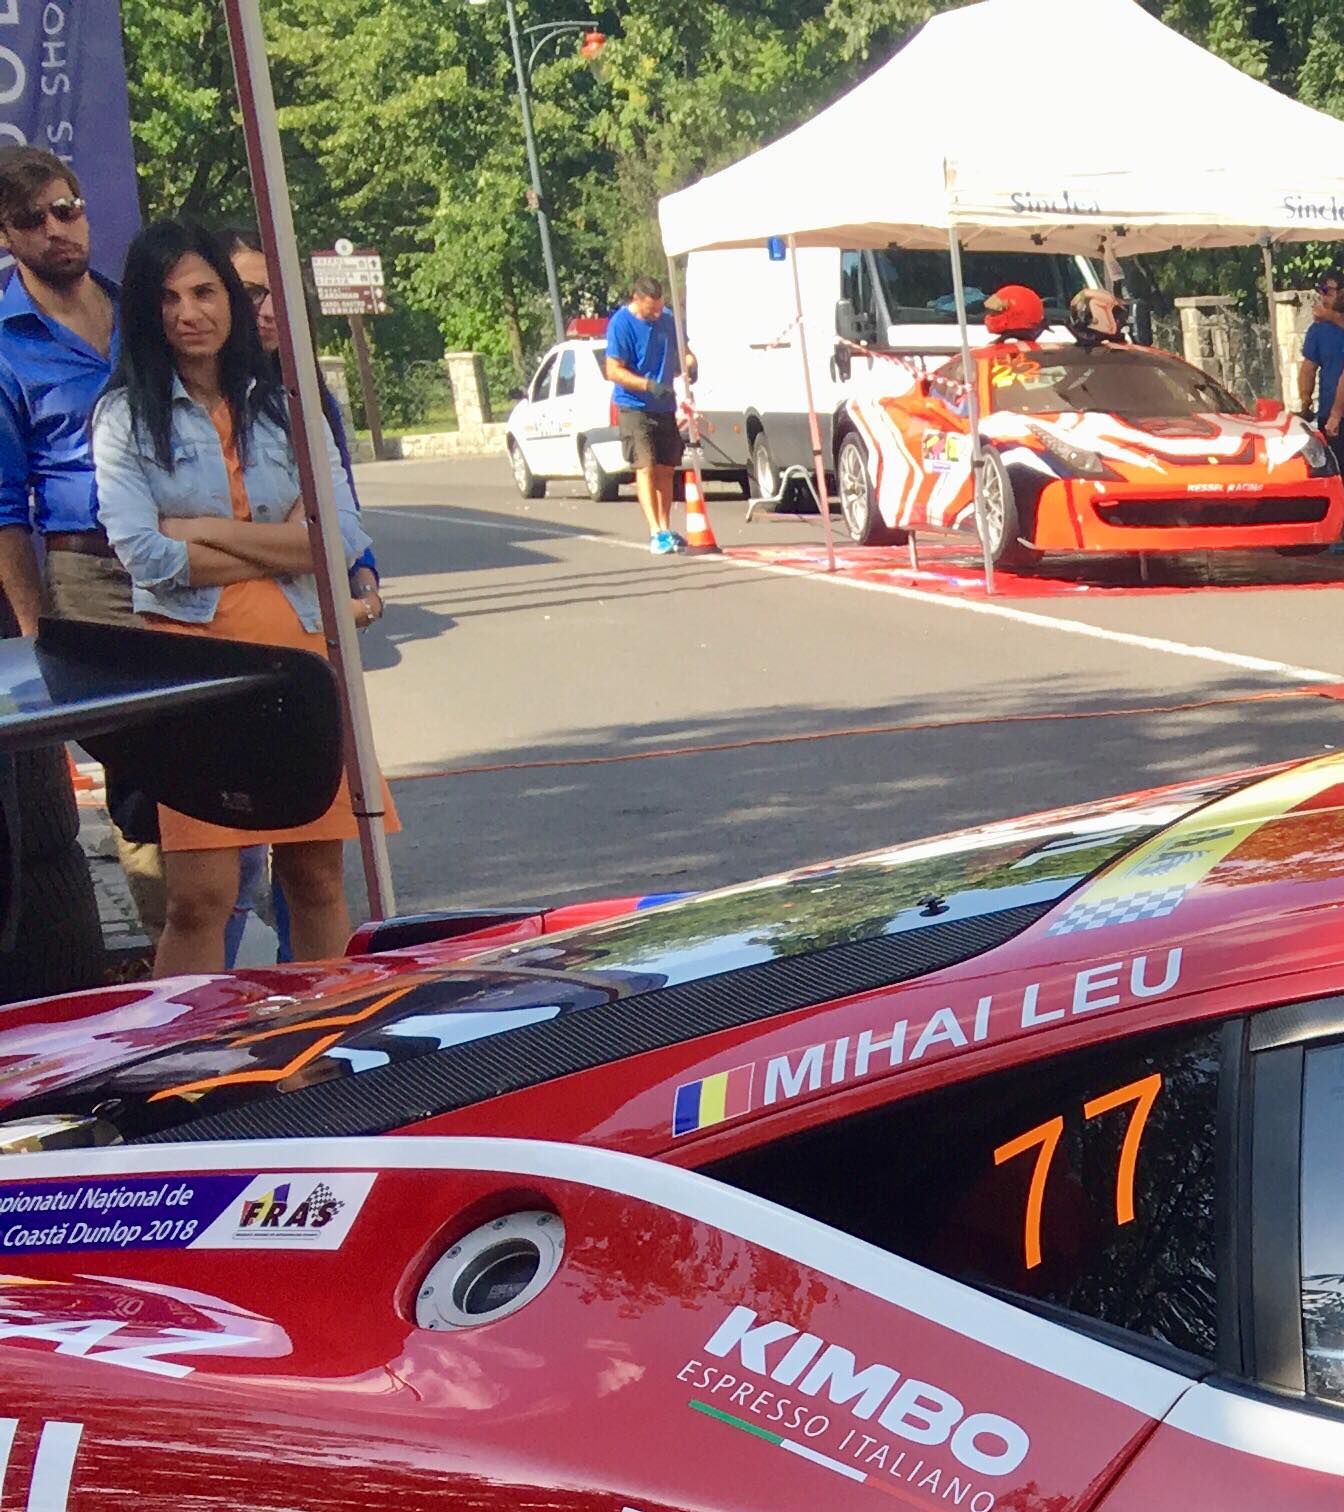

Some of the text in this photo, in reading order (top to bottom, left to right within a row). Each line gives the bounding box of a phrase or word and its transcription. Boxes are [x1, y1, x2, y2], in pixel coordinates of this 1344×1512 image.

[764, 948, 1182, 1106] MIHAI LEU
[165, 1184, 194, 1207] de
[993, 1074, 1162, 1270] 77
[3, 1219, 199, 1247] Coastă Dunlop 2018
[239, 1200, 341, 1228] FRAS
[0, 1307, 260, 1378] AZ
[676, 1360, 824, 1439] ESPRESSO
[703, 1306, 1030, 1477] KIMBO
